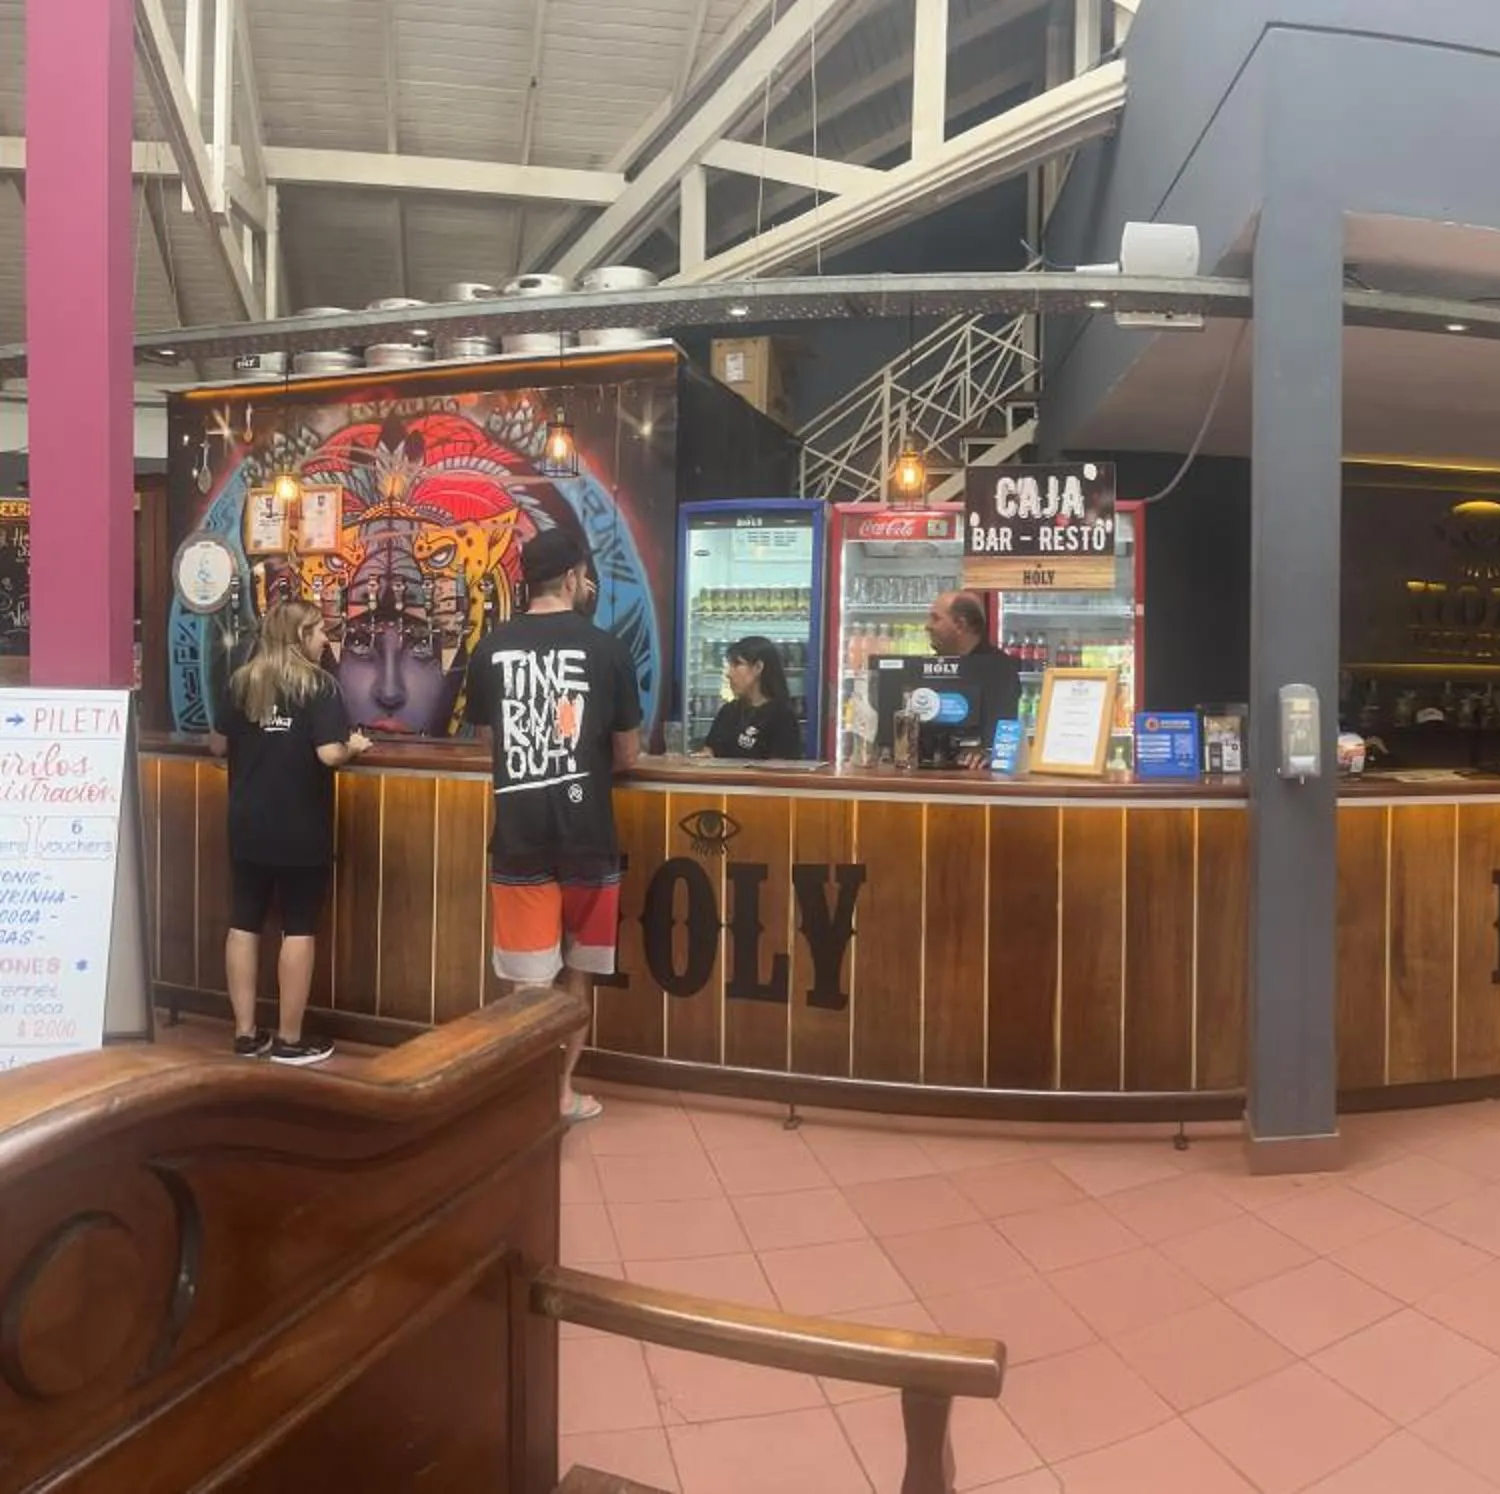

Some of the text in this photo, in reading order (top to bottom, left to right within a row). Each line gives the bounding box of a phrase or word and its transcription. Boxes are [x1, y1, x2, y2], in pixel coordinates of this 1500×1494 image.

[995, 476, 1085, 519] CAJA
[972, 527, 1013, 551] BAR
[1023, 570, 1056, 585] HOLY
[923, 663, 959, 674] HOLY
[33, 707, 121, 733] PILETA
[71, 819, 84, 835] 6
[593, 854, 867, 1011] OLY
